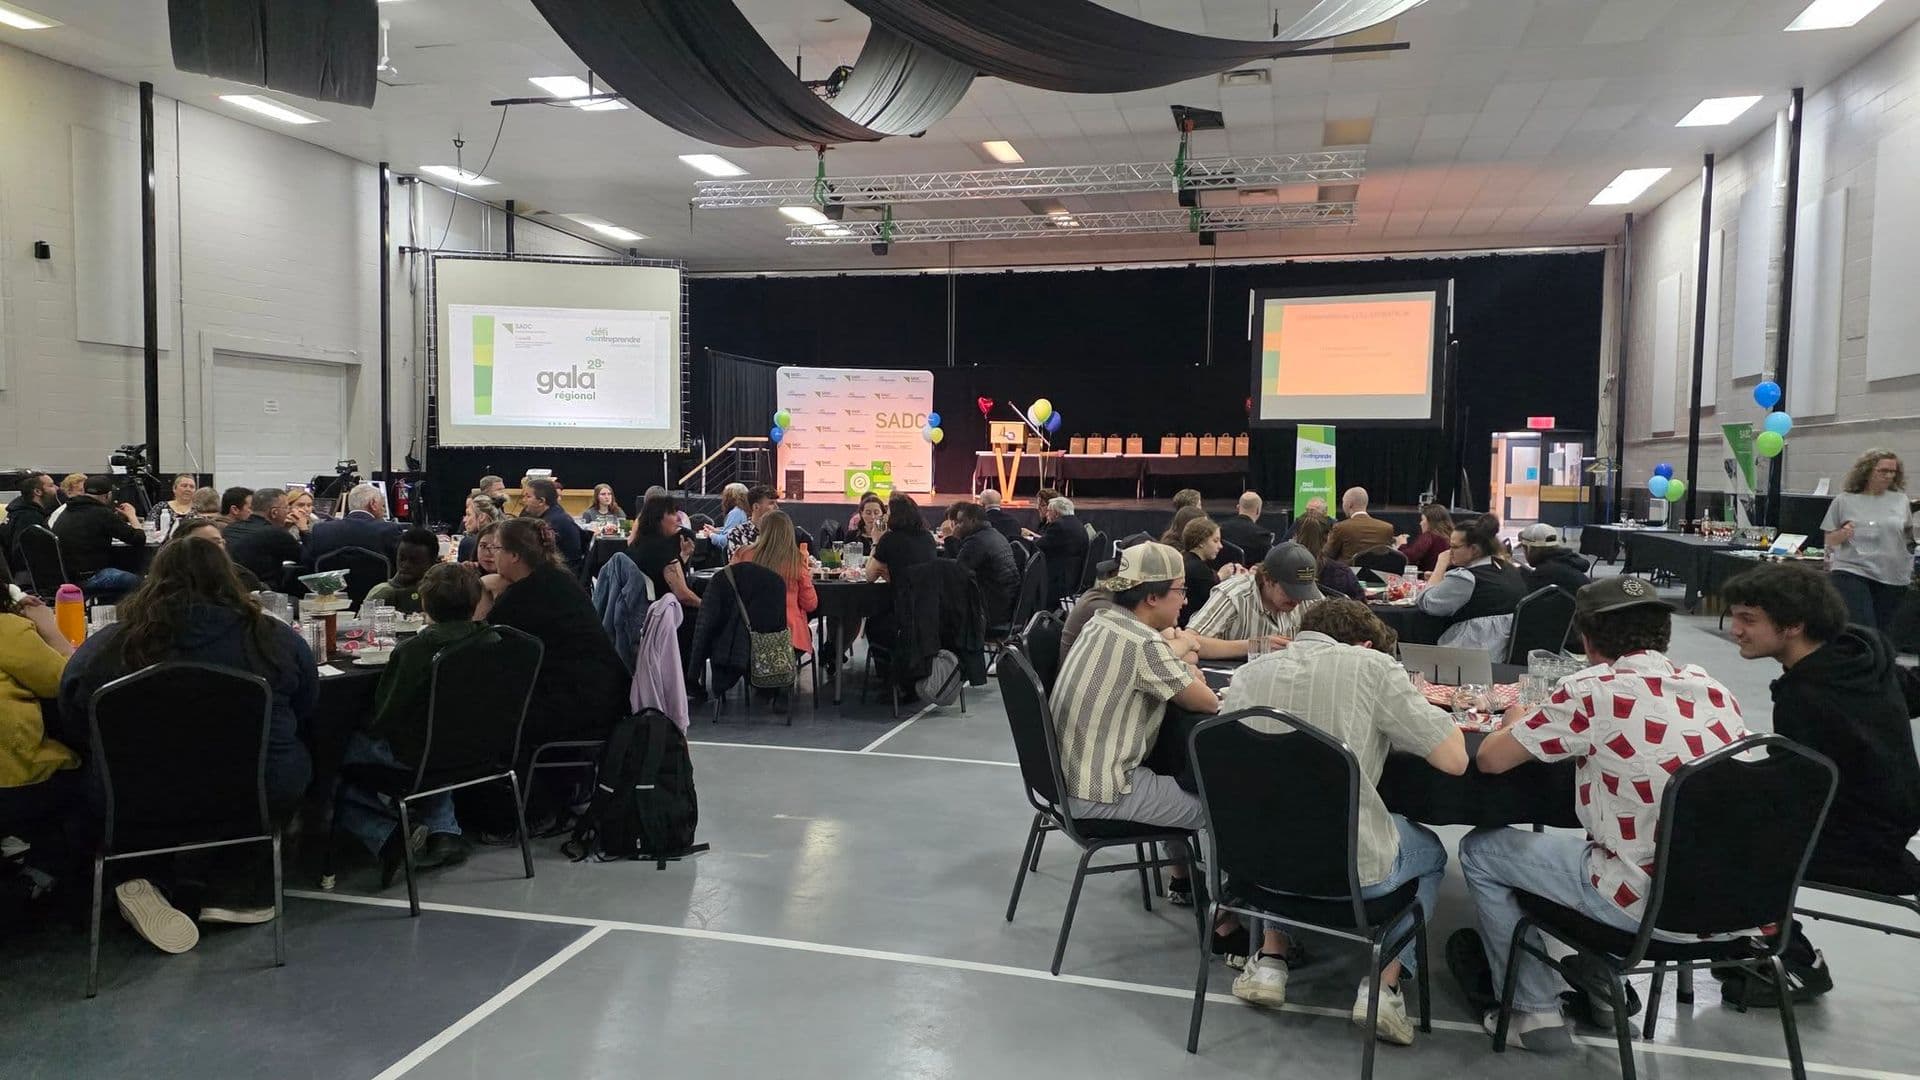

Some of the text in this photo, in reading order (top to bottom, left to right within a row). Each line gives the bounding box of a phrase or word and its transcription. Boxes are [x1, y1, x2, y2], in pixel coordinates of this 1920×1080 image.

[536, 364, 596, 394] gala
[555, 391, 596, 401] régional
[876, 411, 927, 429] SADC
